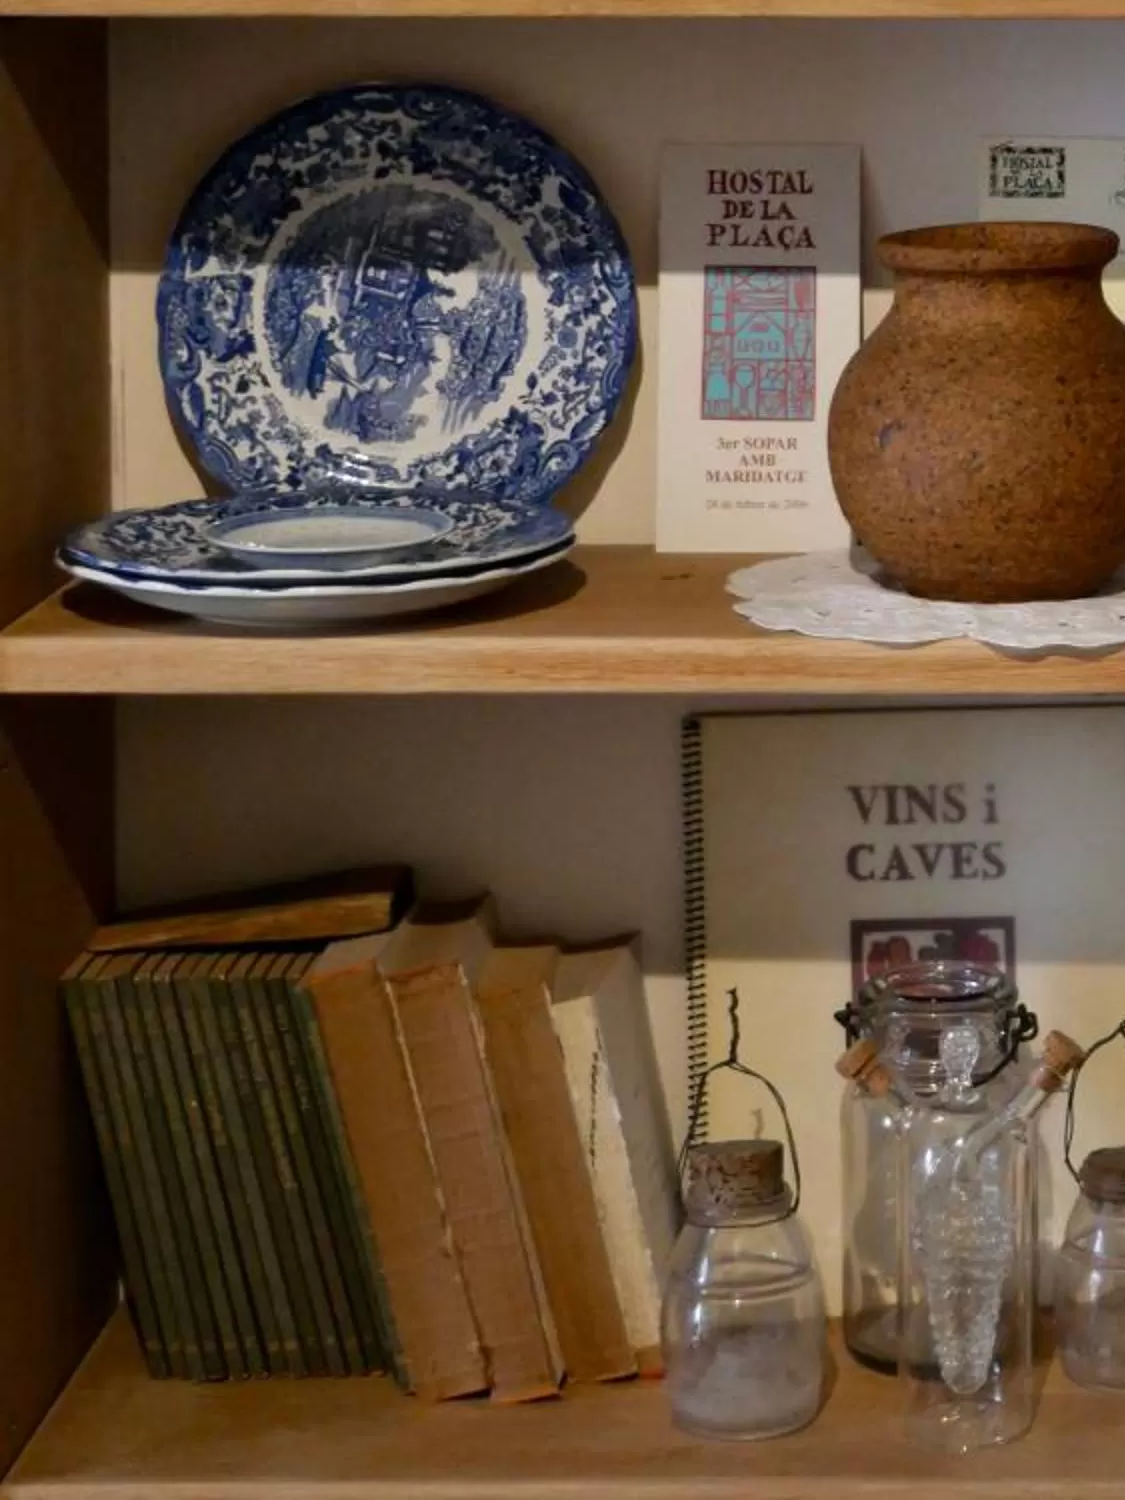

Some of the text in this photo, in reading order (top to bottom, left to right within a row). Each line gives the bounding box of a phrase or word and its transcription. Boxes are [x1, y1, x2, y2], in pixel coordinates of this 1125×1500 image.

[706, 168, 813, 196] HOSTAL
[721, 199, 798, 221] DE LA
[706, 223, 816, 251] PLAÇA
[742, 436, 798, 451] SOPAR
[739, 453, 777, 468] AMB
[705, 468, 807, 484] MARIDATGE
[846, 782, 999, 826] VINS i
[846, 841, 1008, 883] CAVES
